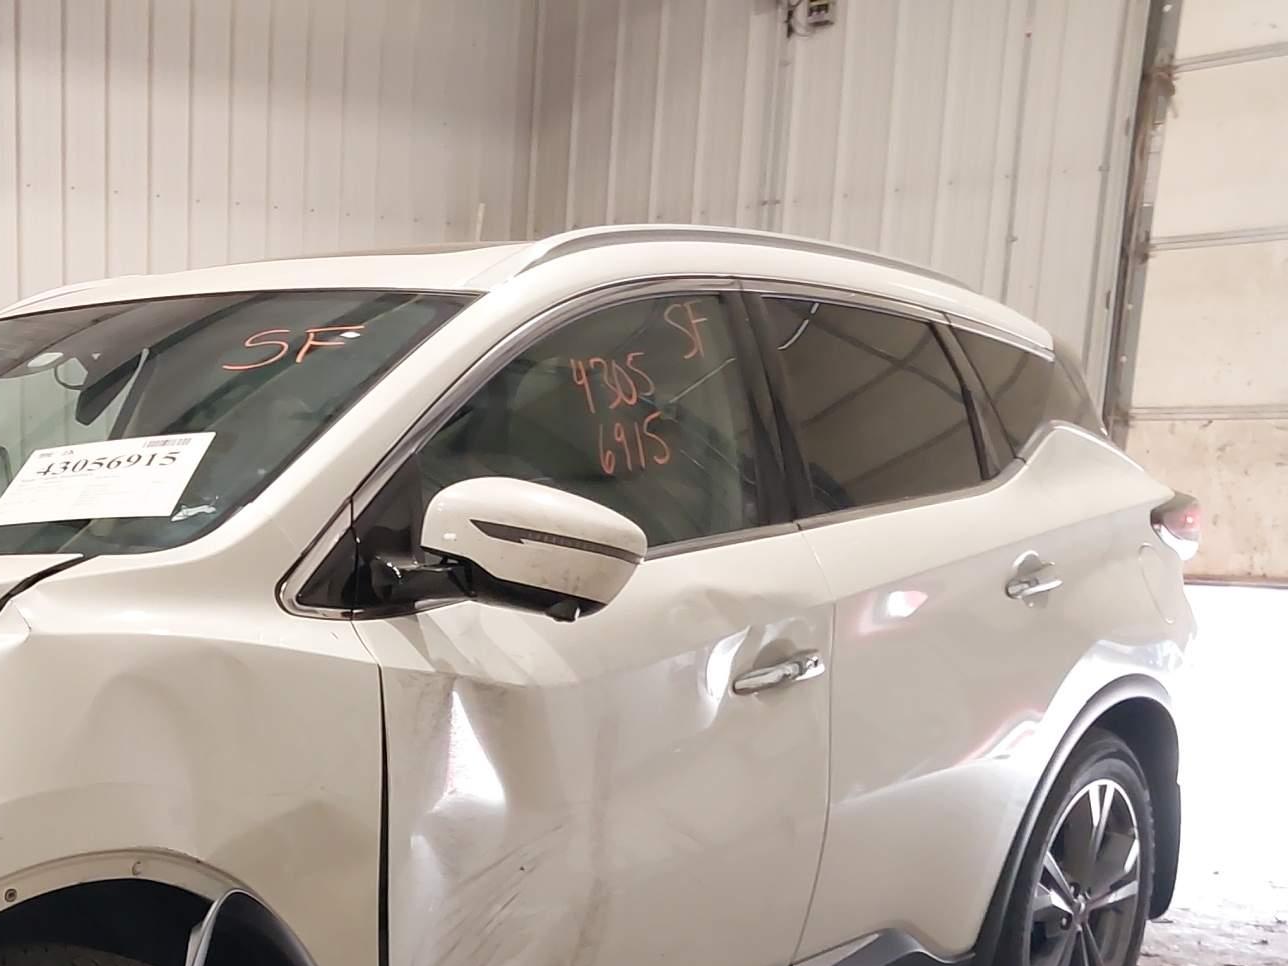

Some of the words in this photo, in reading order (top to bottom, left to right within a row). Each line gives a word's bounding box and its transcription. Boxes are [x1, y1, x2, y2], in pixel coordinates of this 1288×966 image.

[223, 325, 365, 371] SF
[664, 299, 708, 360] SF
[569, 352, 656, 414] 4305
[36, 451, 181, 476] 43056915
[599, 411, 671, 474] 6915
